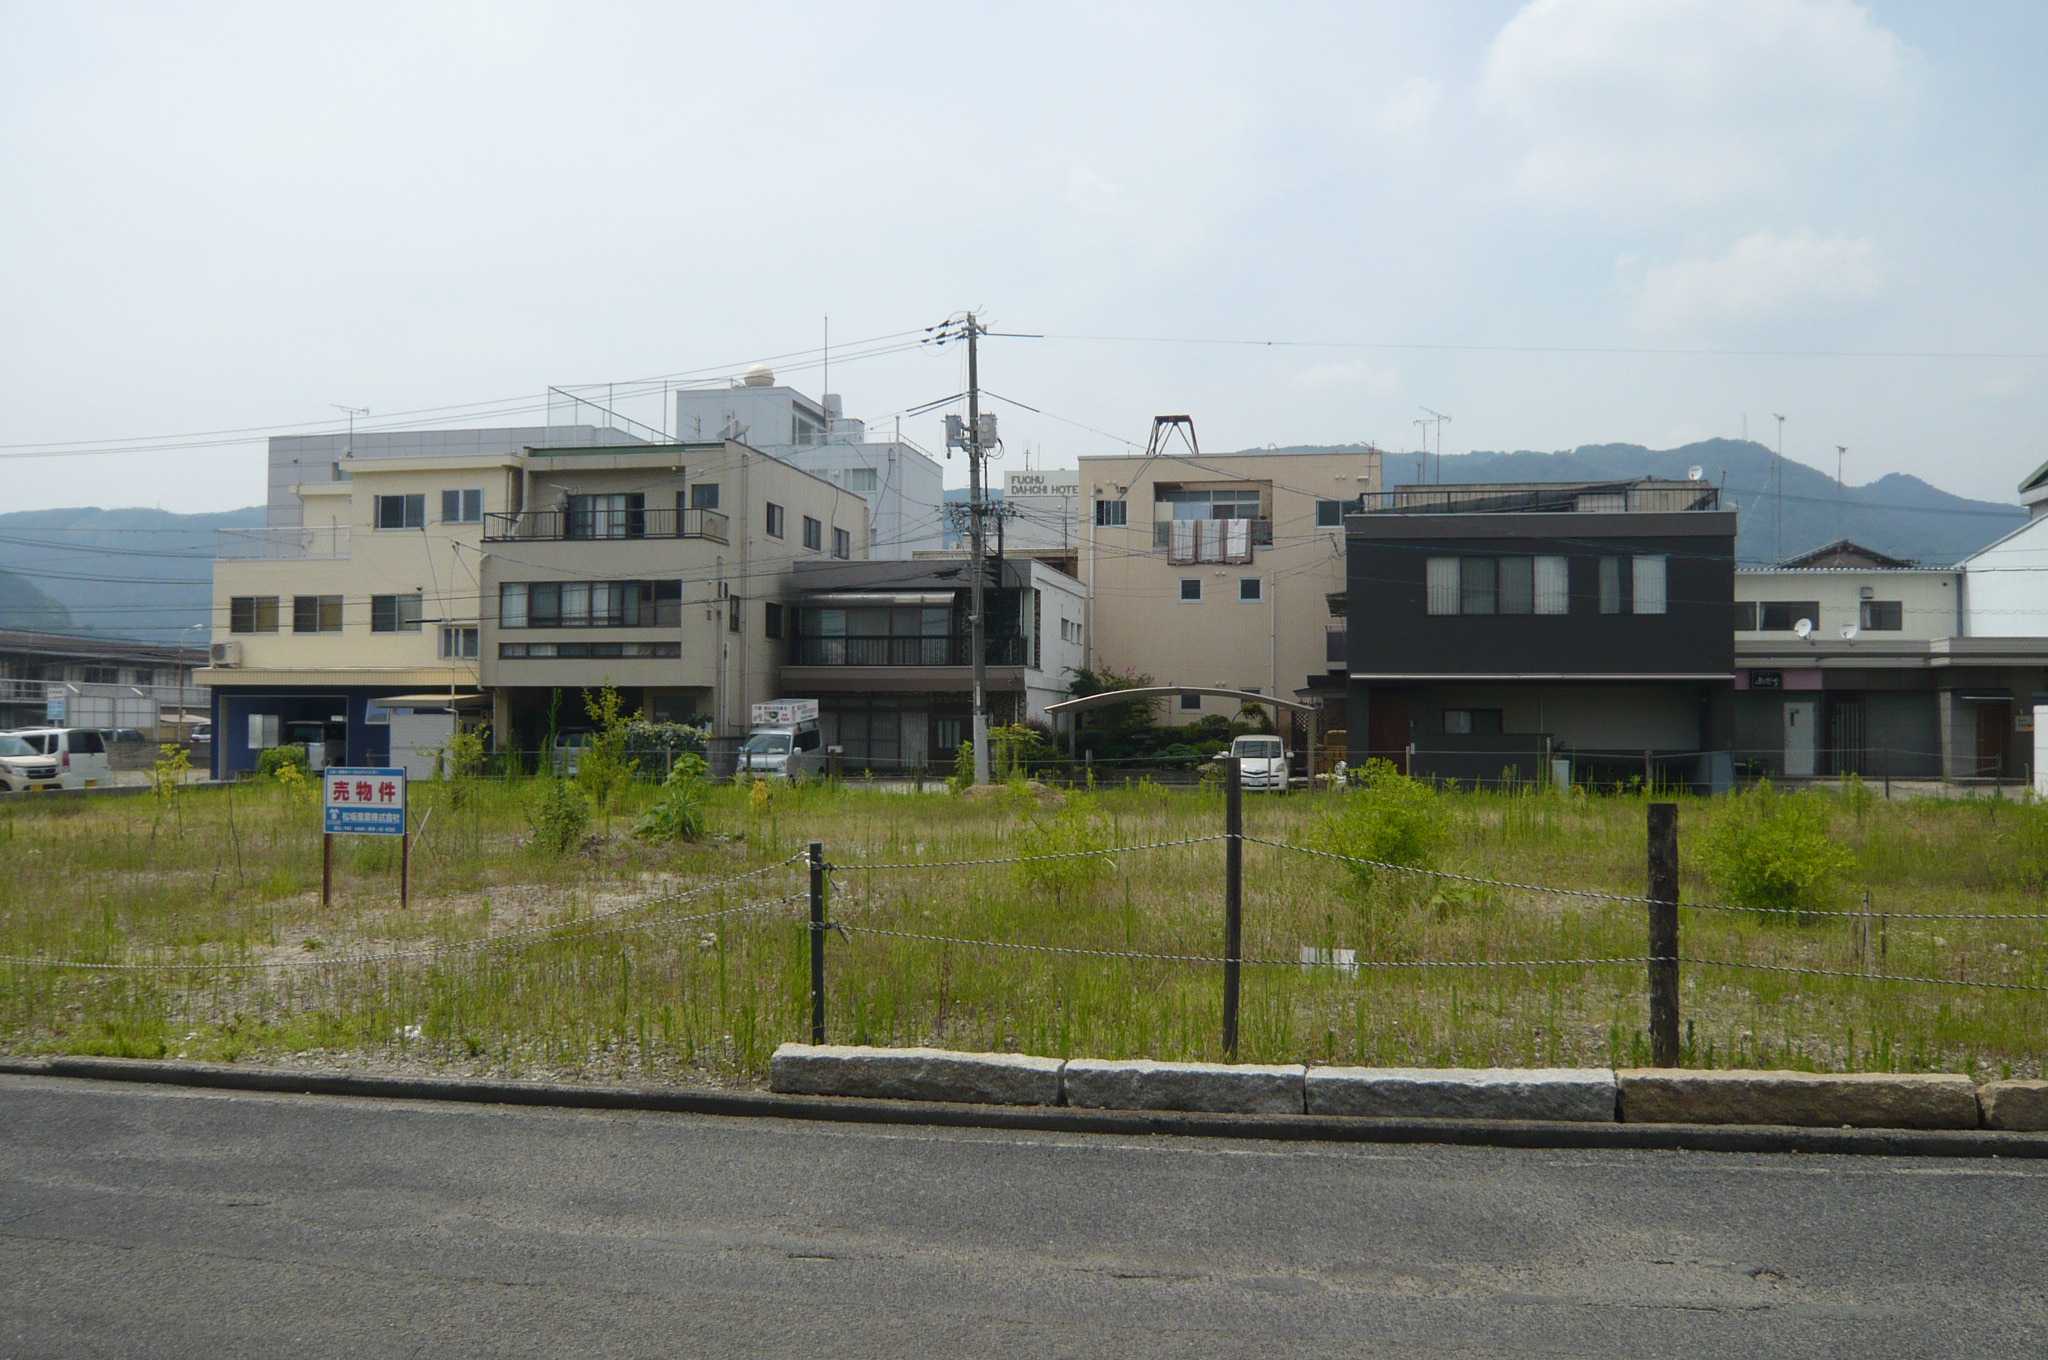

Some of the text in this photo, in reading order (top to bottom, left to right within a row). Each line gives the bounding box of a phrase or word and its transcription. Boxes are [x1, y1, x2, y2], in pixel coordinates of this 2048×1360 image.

[1011, 475, 1044, 484] FUCHU
[333, 781, 396, 802] 売物件
